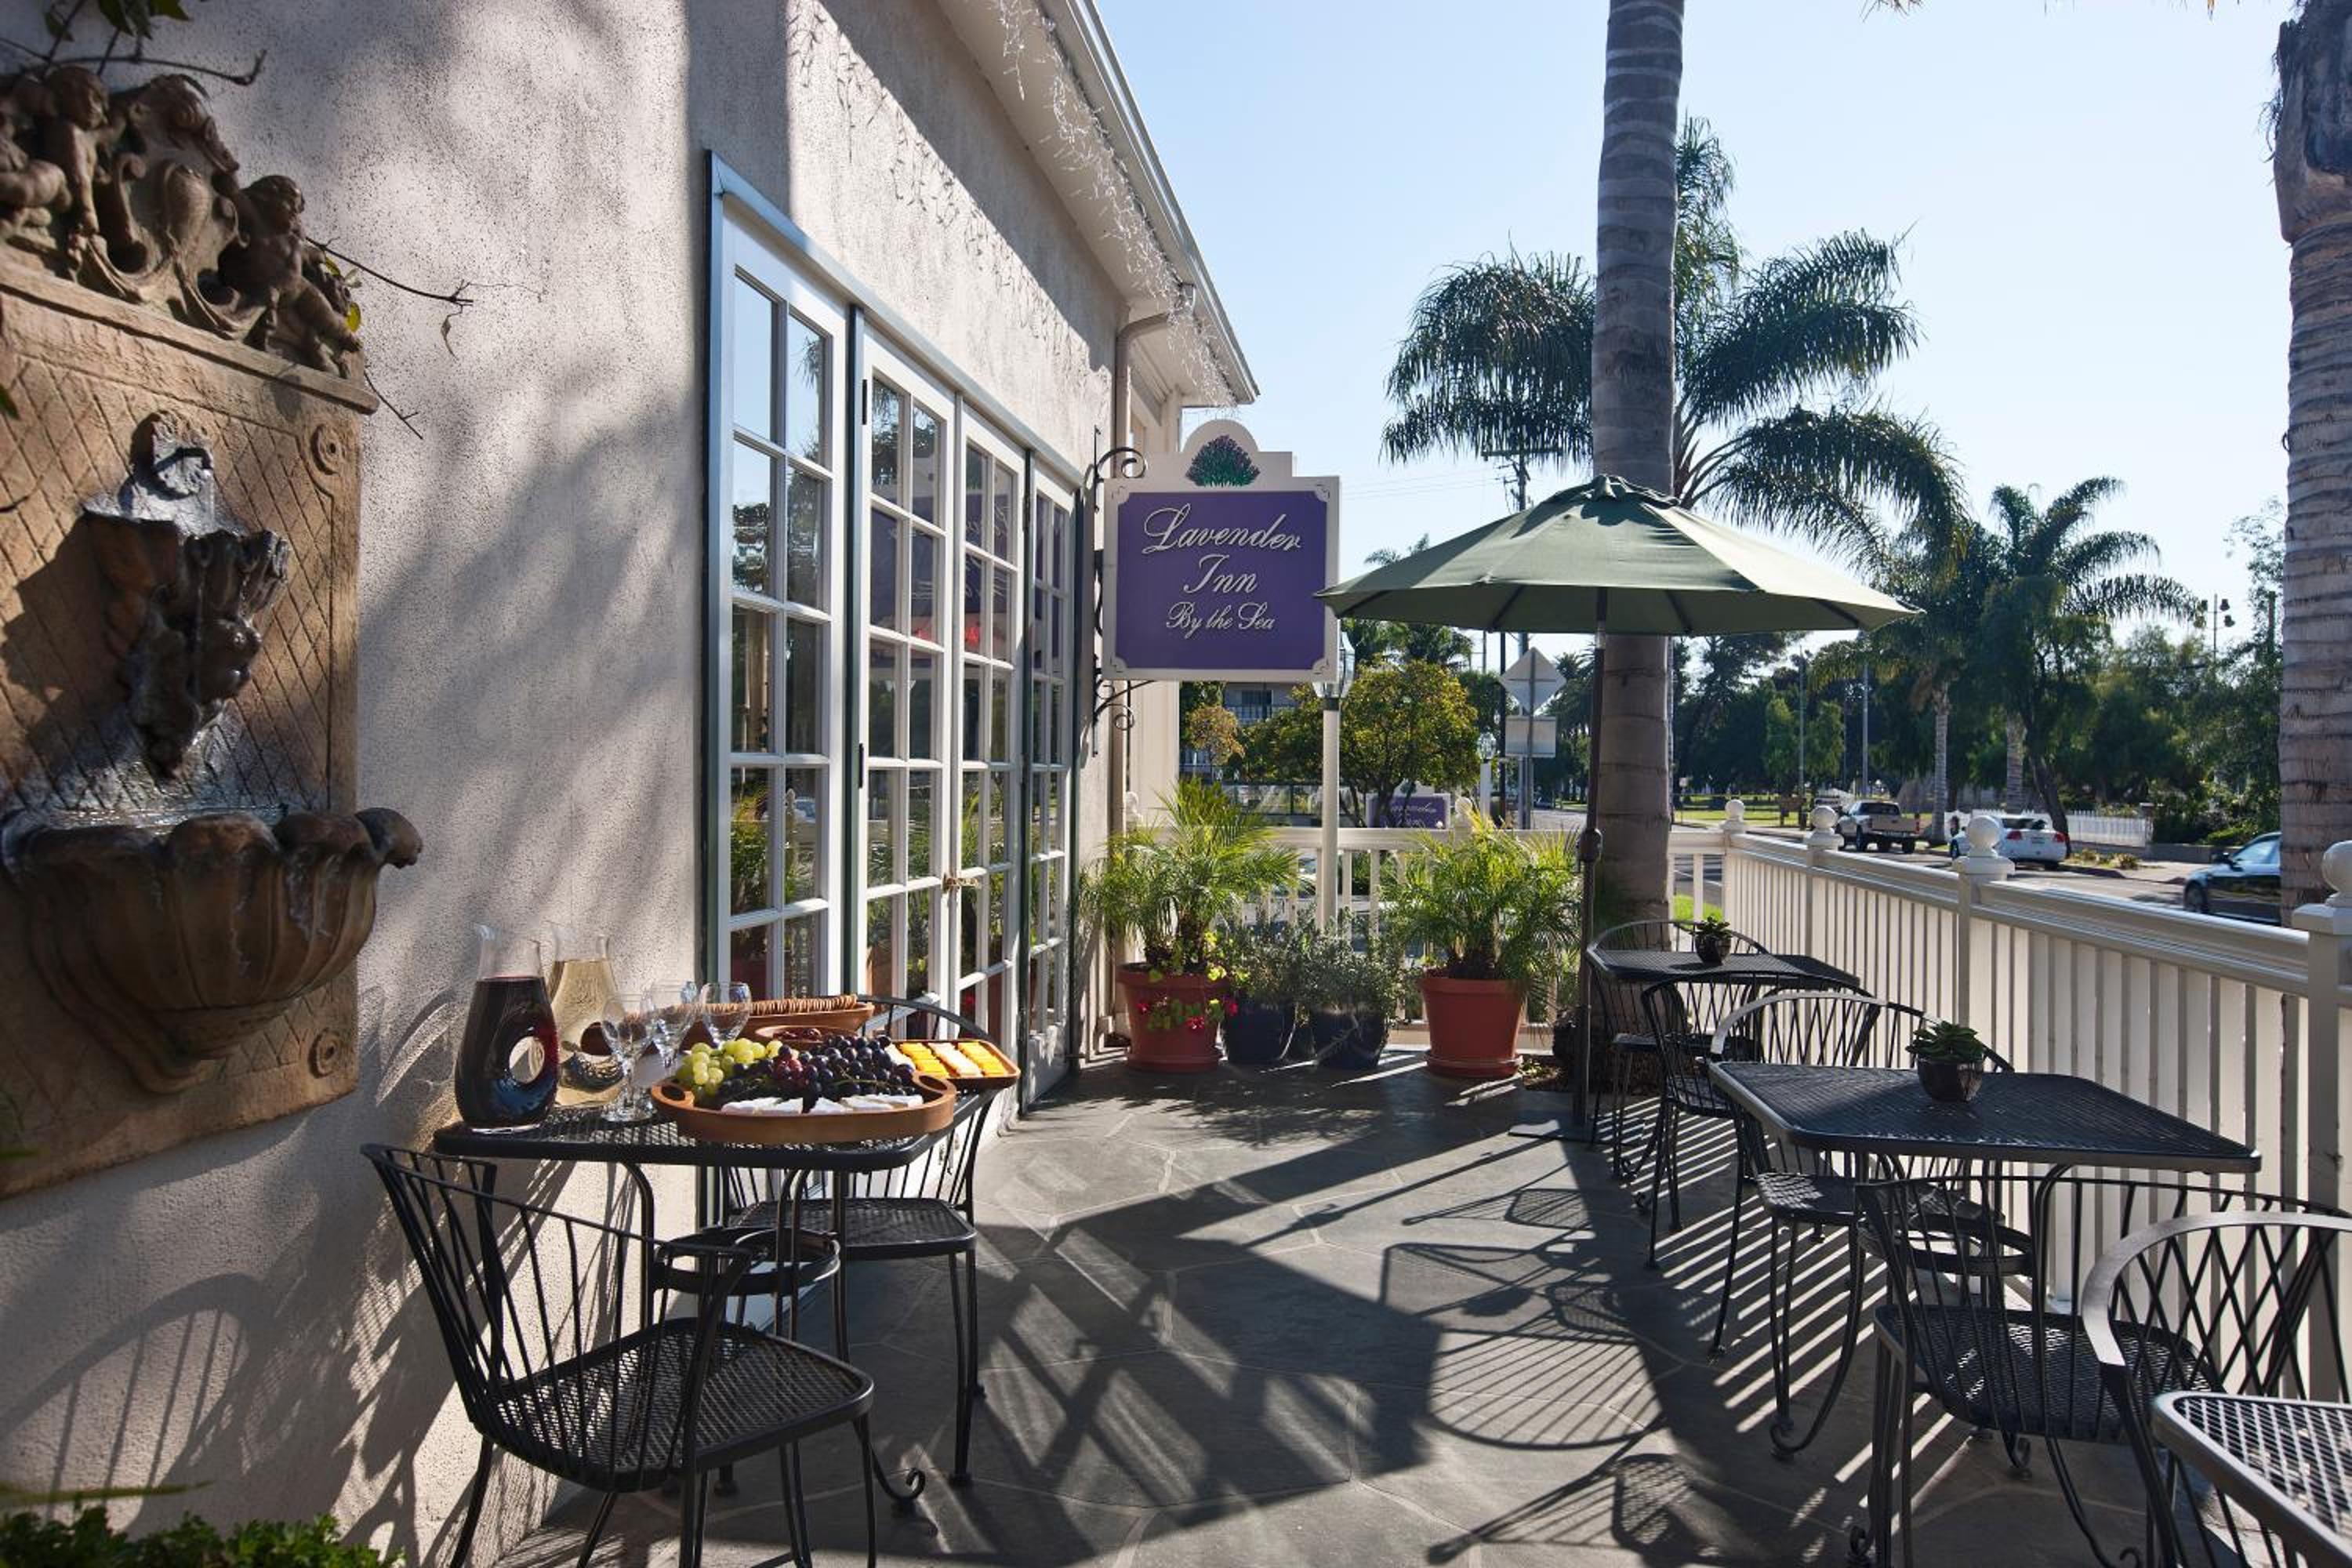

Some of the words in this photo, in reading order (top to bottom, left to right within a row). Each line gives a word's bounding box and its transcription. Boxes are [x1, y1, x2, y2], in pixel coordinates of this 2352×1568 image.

[1142, 503, 1301, 554] Lavender
[1183, 554, 1258, 593] Inn
[1166, 601, 1203, 639] By
[1206, 604, 1234, 629] the
[1238, 601, 1276, 630] Sea
